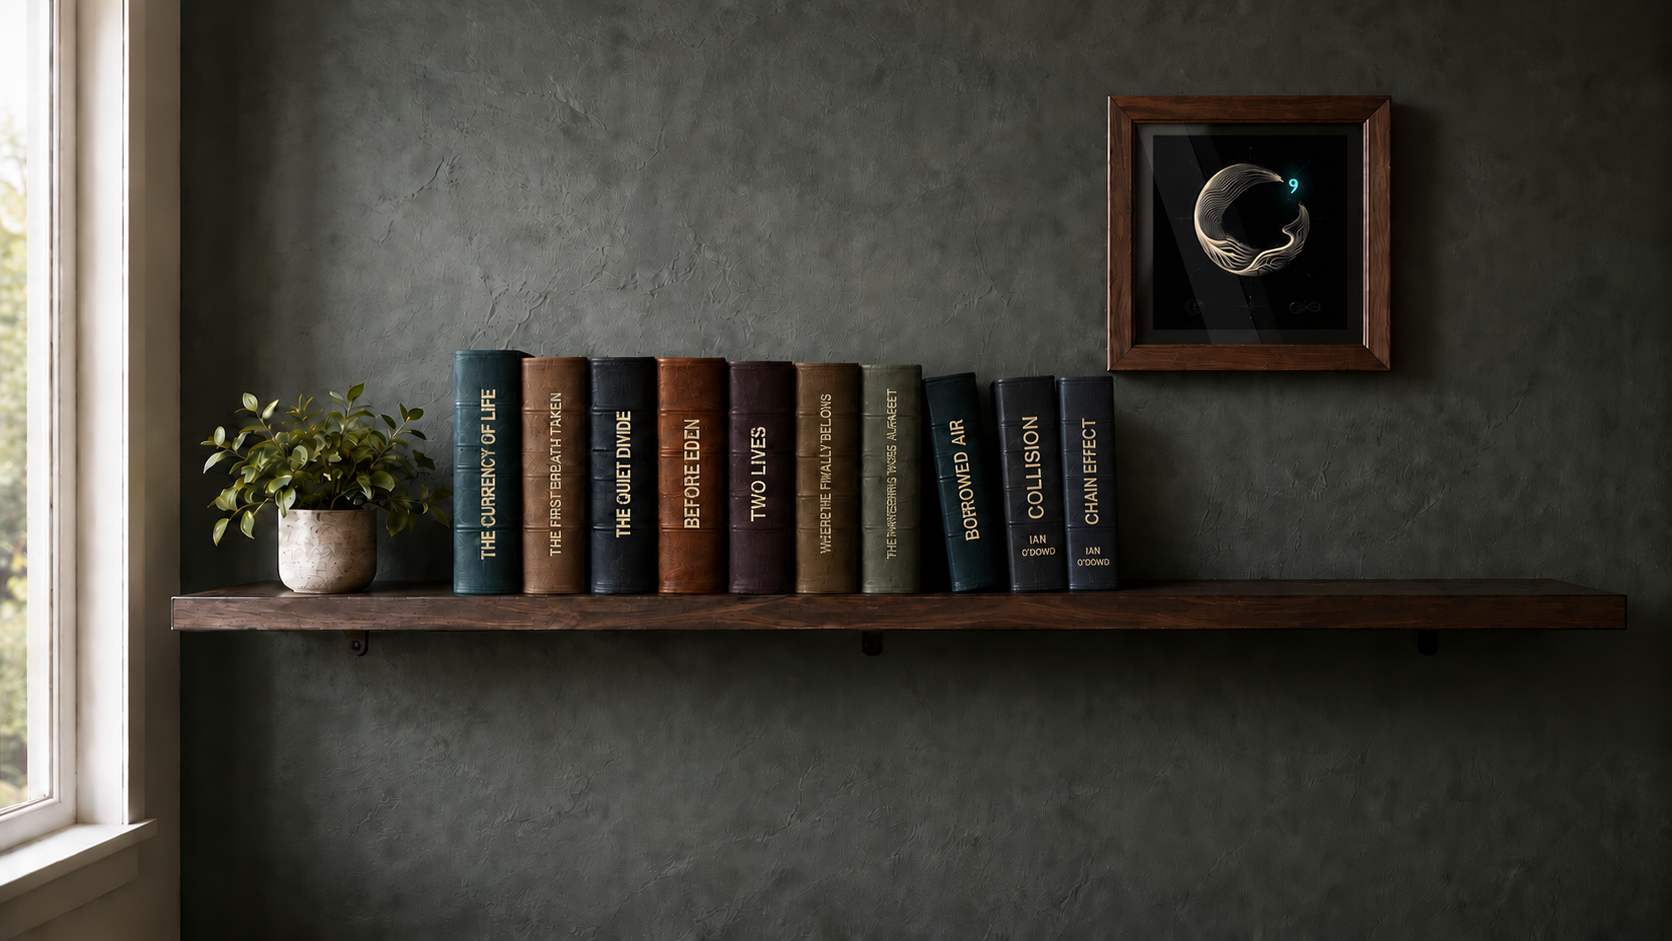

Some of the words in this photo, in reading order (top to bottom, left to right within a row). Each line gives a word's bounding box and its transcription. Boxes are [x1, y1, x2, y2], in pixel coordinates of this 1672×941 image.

[480, 389, 496, 421] LIFE
[550, 393, 562, 436] TAKEN
[480, 424, 496, 445] OF
[616, 411, 631, 458] DIVIDE
[684, 419, 700, 461] EDEN
[750, 426, 767, 476] LIVES
[949, 419, 966, 446] AIR
[1081, 418, 1097, 474] EFFECT
[616, 461, 631, 505] QUIET
[1021, 416, 1045, 519] COLLISION
[480, 447, 496, 527] CURRENCY
[684, 464, 700, 529] BEFORE
[750, 480, 766, 522] TWO
[1083, 477, 1099, 525] CHAIN
[616, 508, 631, 538] THE
[1029, 534, 1046, 545] IAN
[480, 531, 496, 560] THE
[550, 531, 562, 557] THE
[886, 538, 897, 560] THE
[1021, 547, 1056, 557] O'DOWD
[1077, 558, 1110, 567] O'DOWD
[1085, 546, 1101, 555] IAN
